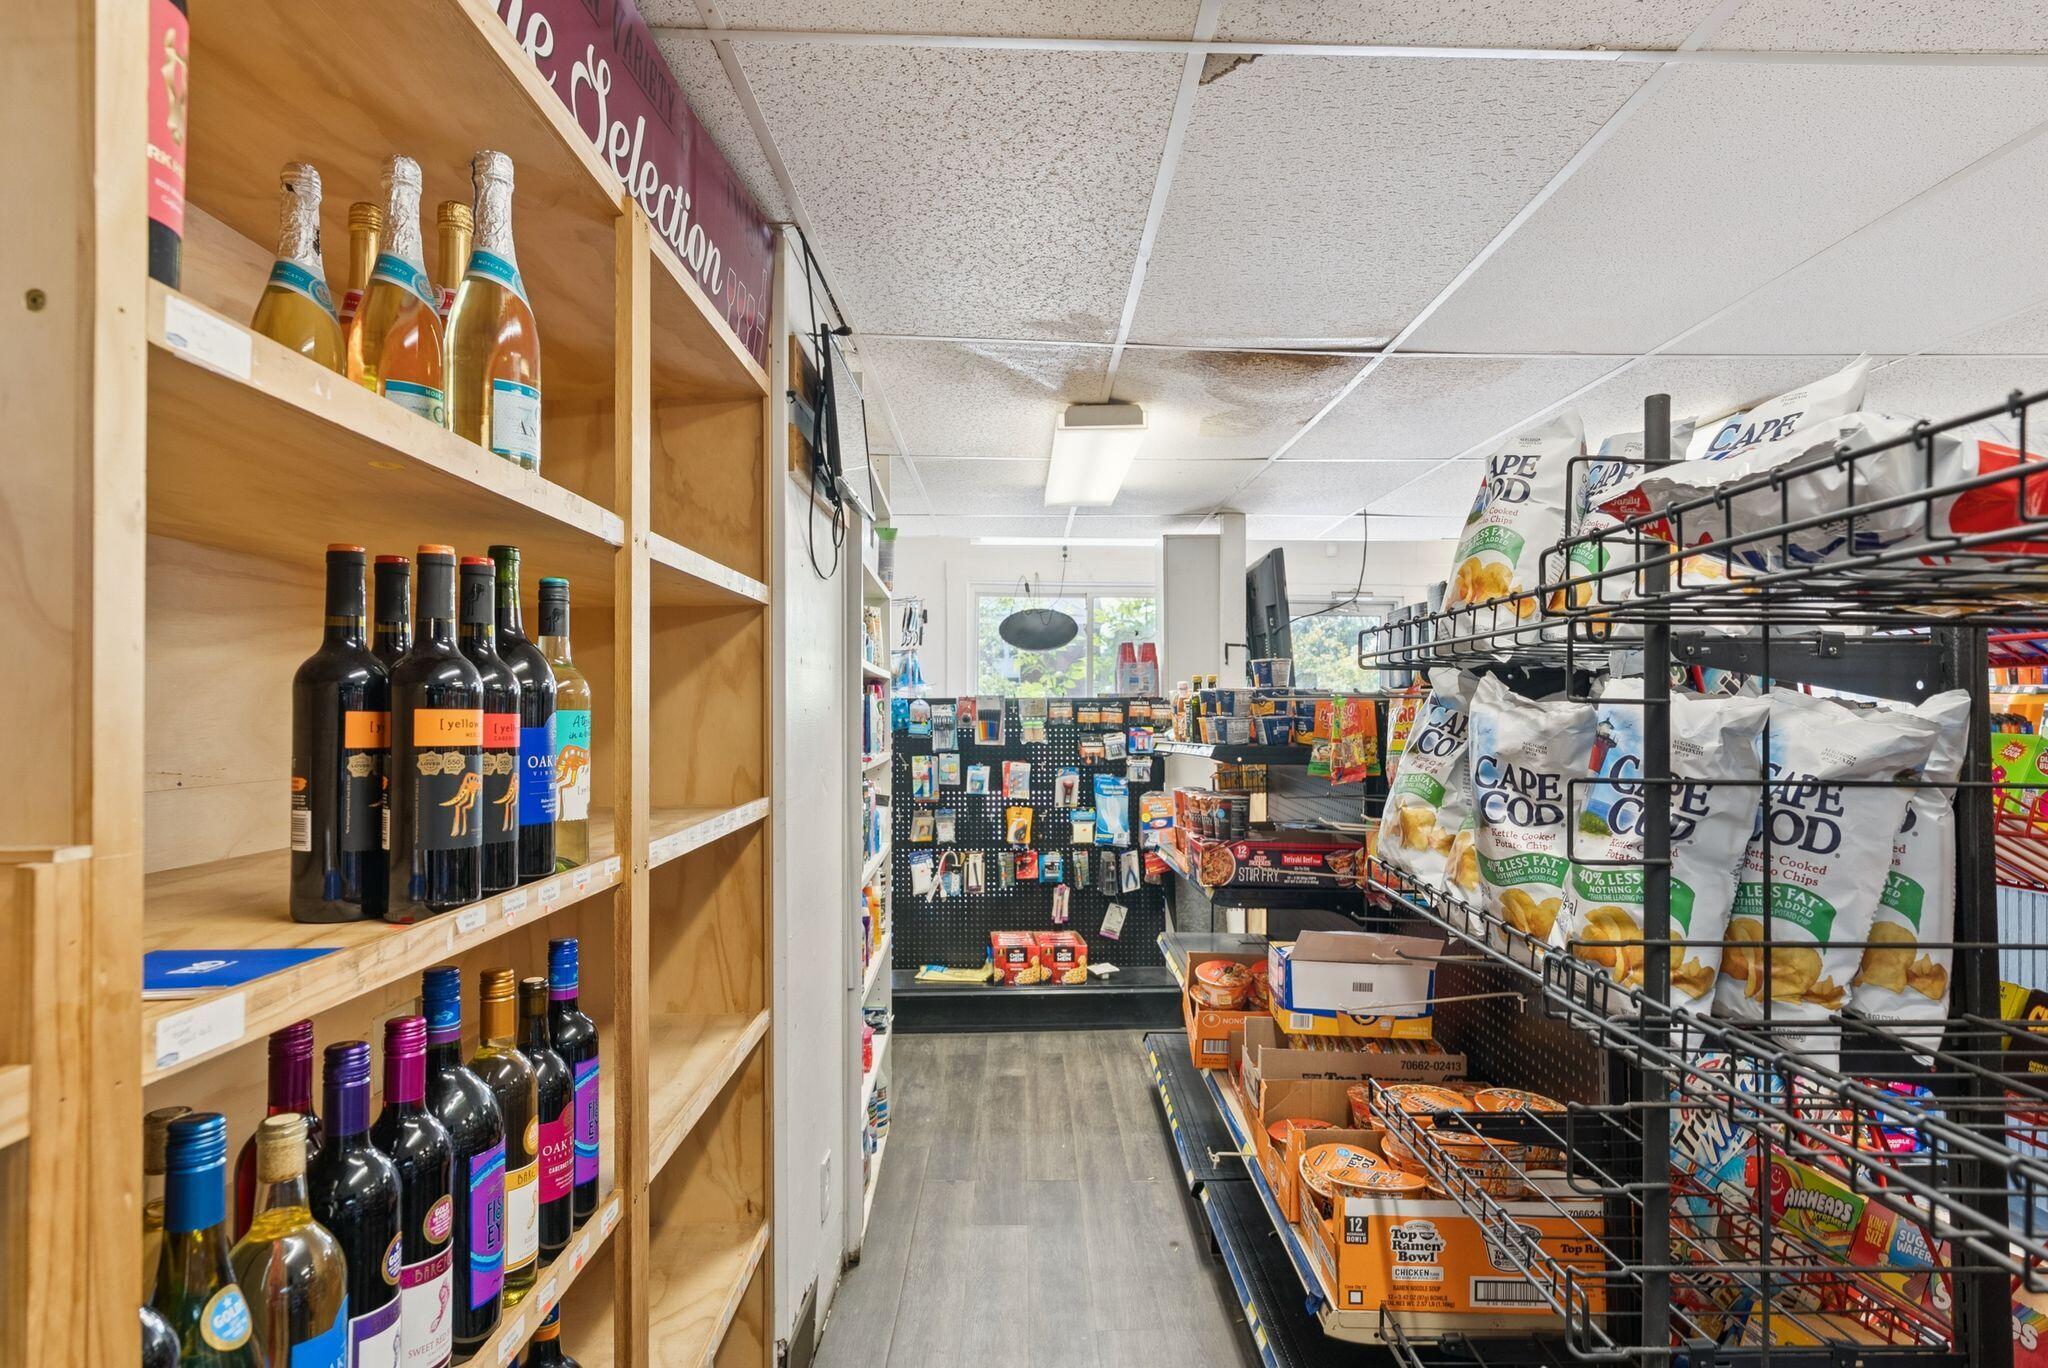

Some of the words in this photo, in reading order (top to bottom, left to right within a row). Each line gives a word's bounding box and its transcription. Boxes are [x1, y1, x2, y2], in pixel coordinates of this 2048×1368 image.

[570, 43, 724, 296] Selection
[377, 260, 408, 276] MOSCATO
[477, 258, 508, 275] MOSCATO
[1708, 411, 1804, 451] CAPE
[1489, 506, 1519, 517] Cooked
[1490, 515, 1513, 525] Chips
[2003, 748, 2021, 760] SOUR
[527, 755, 553, 769] OAK
[1475, 756, 1564, 802] CAPE
[1609, 754, 1714, 817] CPE
[1480, 790, 1565, 828] COD
[1491, 828, 1519, 840] Kettle
[1521, 832, 1557, 841] Cooked
[1238, 845, 1247, 854] 12
[1495, 838, 1522, 850] Potato
[1525, 841, 1553, 851] Chips
[1284, 855, 1302, 864] Teriyaki
[1303, 856, 1313, 864] Beef
[1504, 856, 1530, 871] LESS
[1745, 845, 1775, 861] Kette
[1779, 855, 1828, 876] Cooked
[1238, 866, 1260, 882] STIR
[1262, 867, 1280, 882] FRY
[1527, 867, 1559, 877] ADDED
[1579, 868, 1605, 886] 40%
[1607, 873, 1642, 886] LESS
[1743, 858, 1778, 876] Potao
[1783, 869, 1819, 886] Chips
[1589, 885, 1633, 894] NOTHING
[1746, 885, 1782, 899] LES
[1774, 908, 1797, 919] POTATO
[1775, 899, 1815, 918] ADDED
[1400, 1059, 1462, 1072] 70662-02413
[542, 1139, 568, 1157] OAK
[1783, 1187, 1854, 1223] AIRHEADS
[1349, 1217, 1363, 1232] 12
[1868, 1214, 1888, 1235] KING
[1391, 1229, 1417, 1242] Top
[1865, 1228, 1885, 1247] SIZE
[1391, 1240, 1441, 1251] Ramen
[1560, 1244, 1582, 1255] Top
[1398, 1251, 1435, 1263] Bowl
[1394, 1268, 1430, 1277] CHICKEN
[212, 1298, 247, 1330] GOLD
[408, 1341, 435, 1360] SWEET
